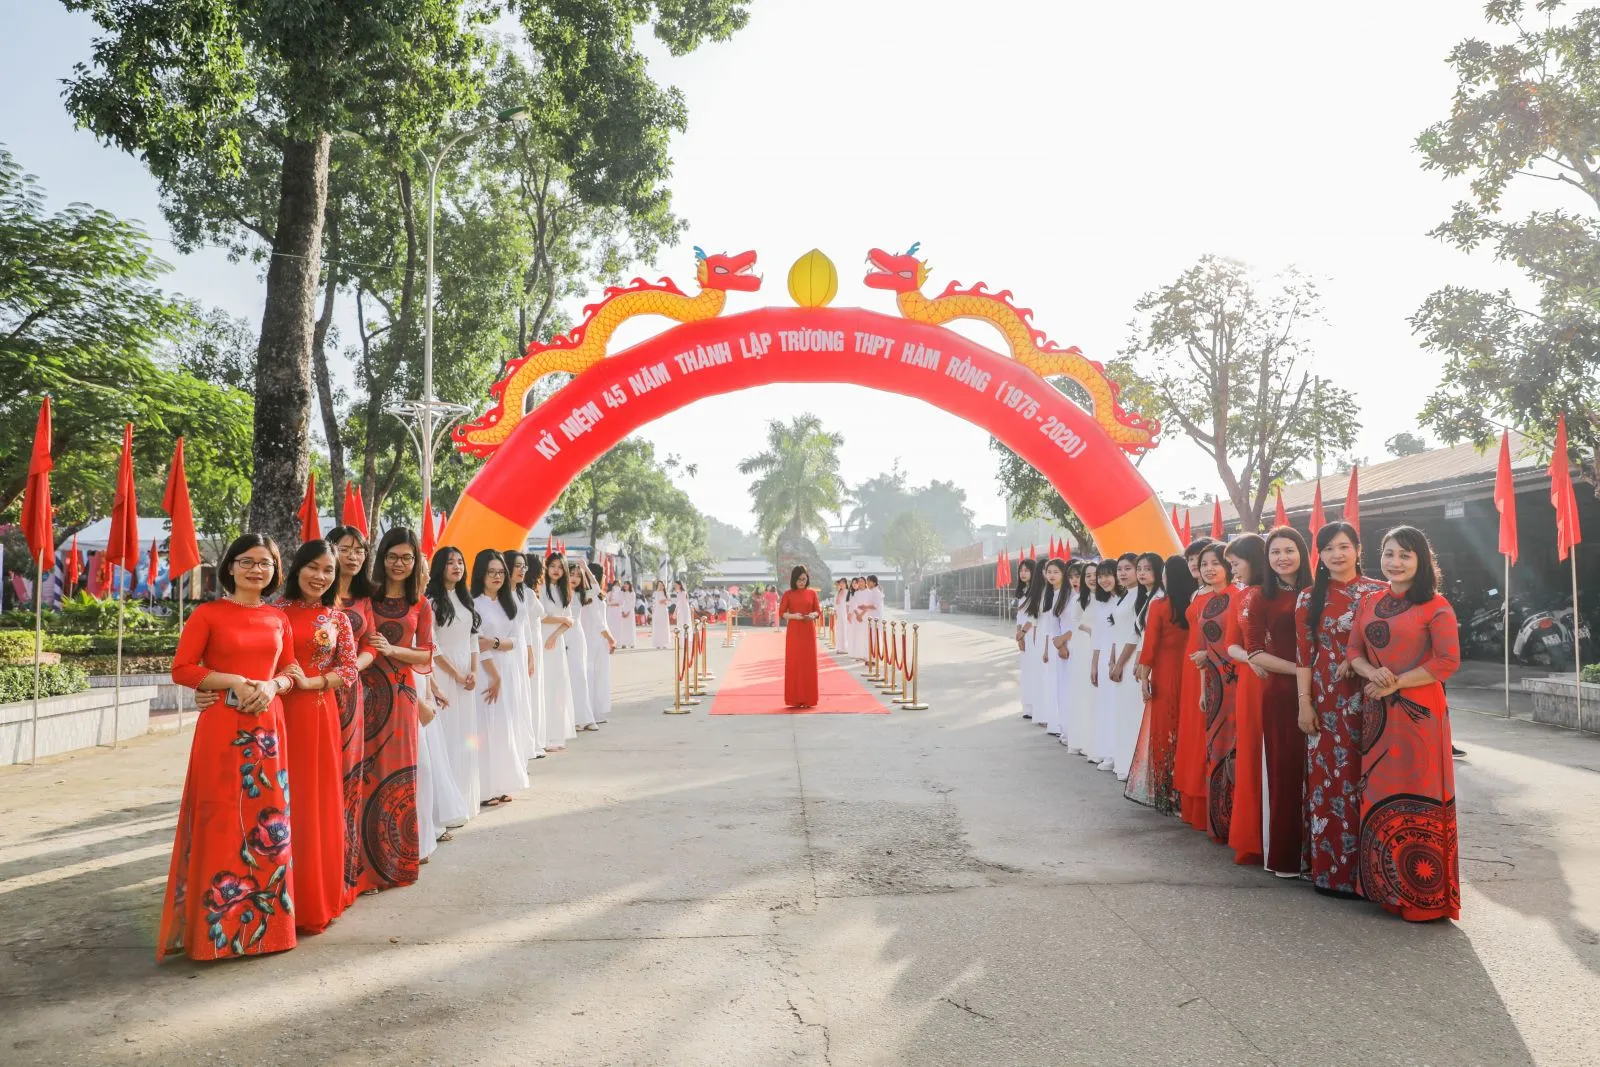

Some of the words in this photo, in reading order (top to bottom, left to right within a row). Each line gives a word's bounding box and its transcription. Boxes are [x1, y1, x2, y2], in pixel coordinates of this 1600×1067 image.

[535, 429, 561, 461] KỶ
[559, 400, 604, 442] NIỆM
[602, 384, 627, 409] 45
[628, 361, 672, 397] NĂM
[674, 341, 733, 375] THÀNH
[739, 332, 772, 360] LẬP
[854, 331, 896, 359] THPT
[900, 342, 941, 371] HÀM
